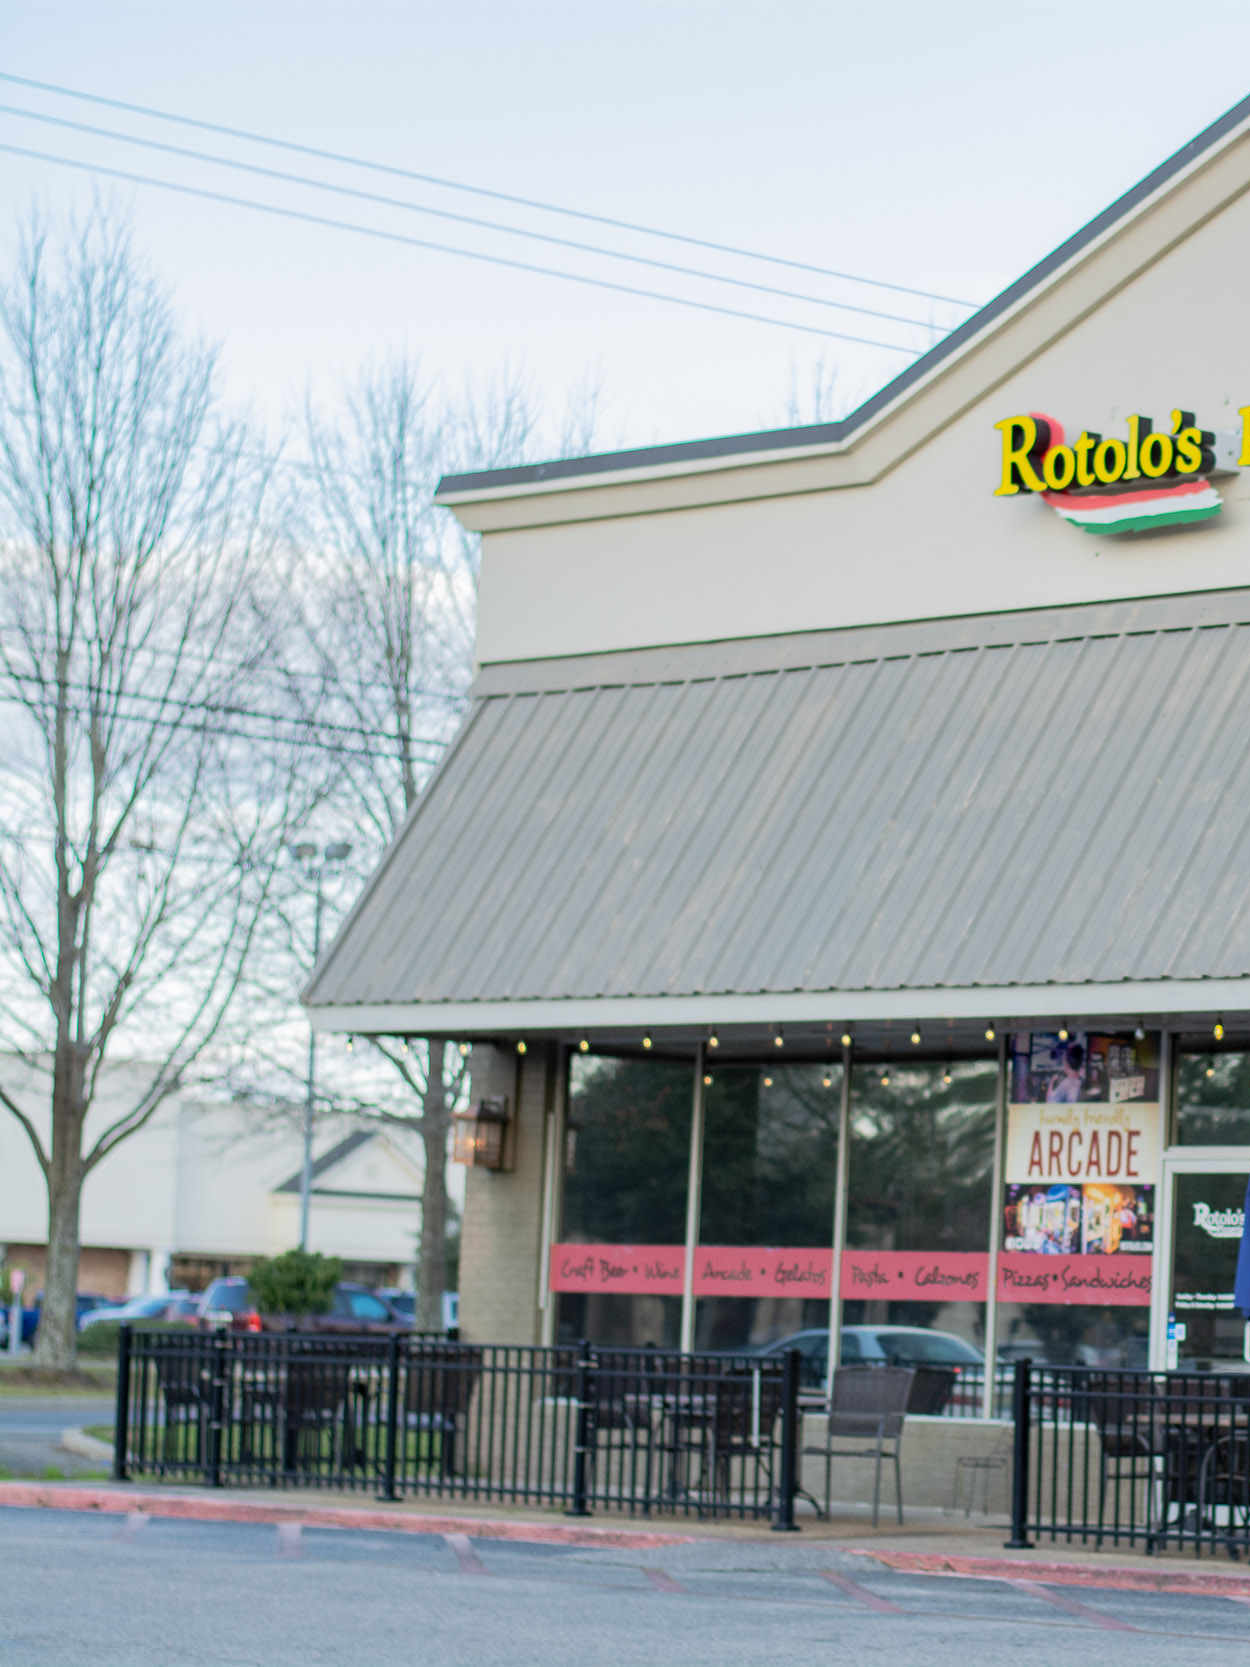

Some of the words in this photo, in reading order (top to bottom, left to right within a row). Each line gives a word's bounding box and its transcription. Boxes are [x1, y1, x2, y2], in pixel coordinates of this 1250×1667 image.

[994, 409, 1203, 496] Rotolo's
[1027, 1130, 1141, 1177] ARCADE
[701, 1259, 753, 1281] Arcade
[774, 1260, 828, 1288] Gelatos
[851, 1262, 889, 1288] Pasta
[914, 1264, 980, 1290] Calzones
[1001, 1267, 1051, 1291] Pizzas
[1061, 1264, 1153, 1294] Sandwiches
